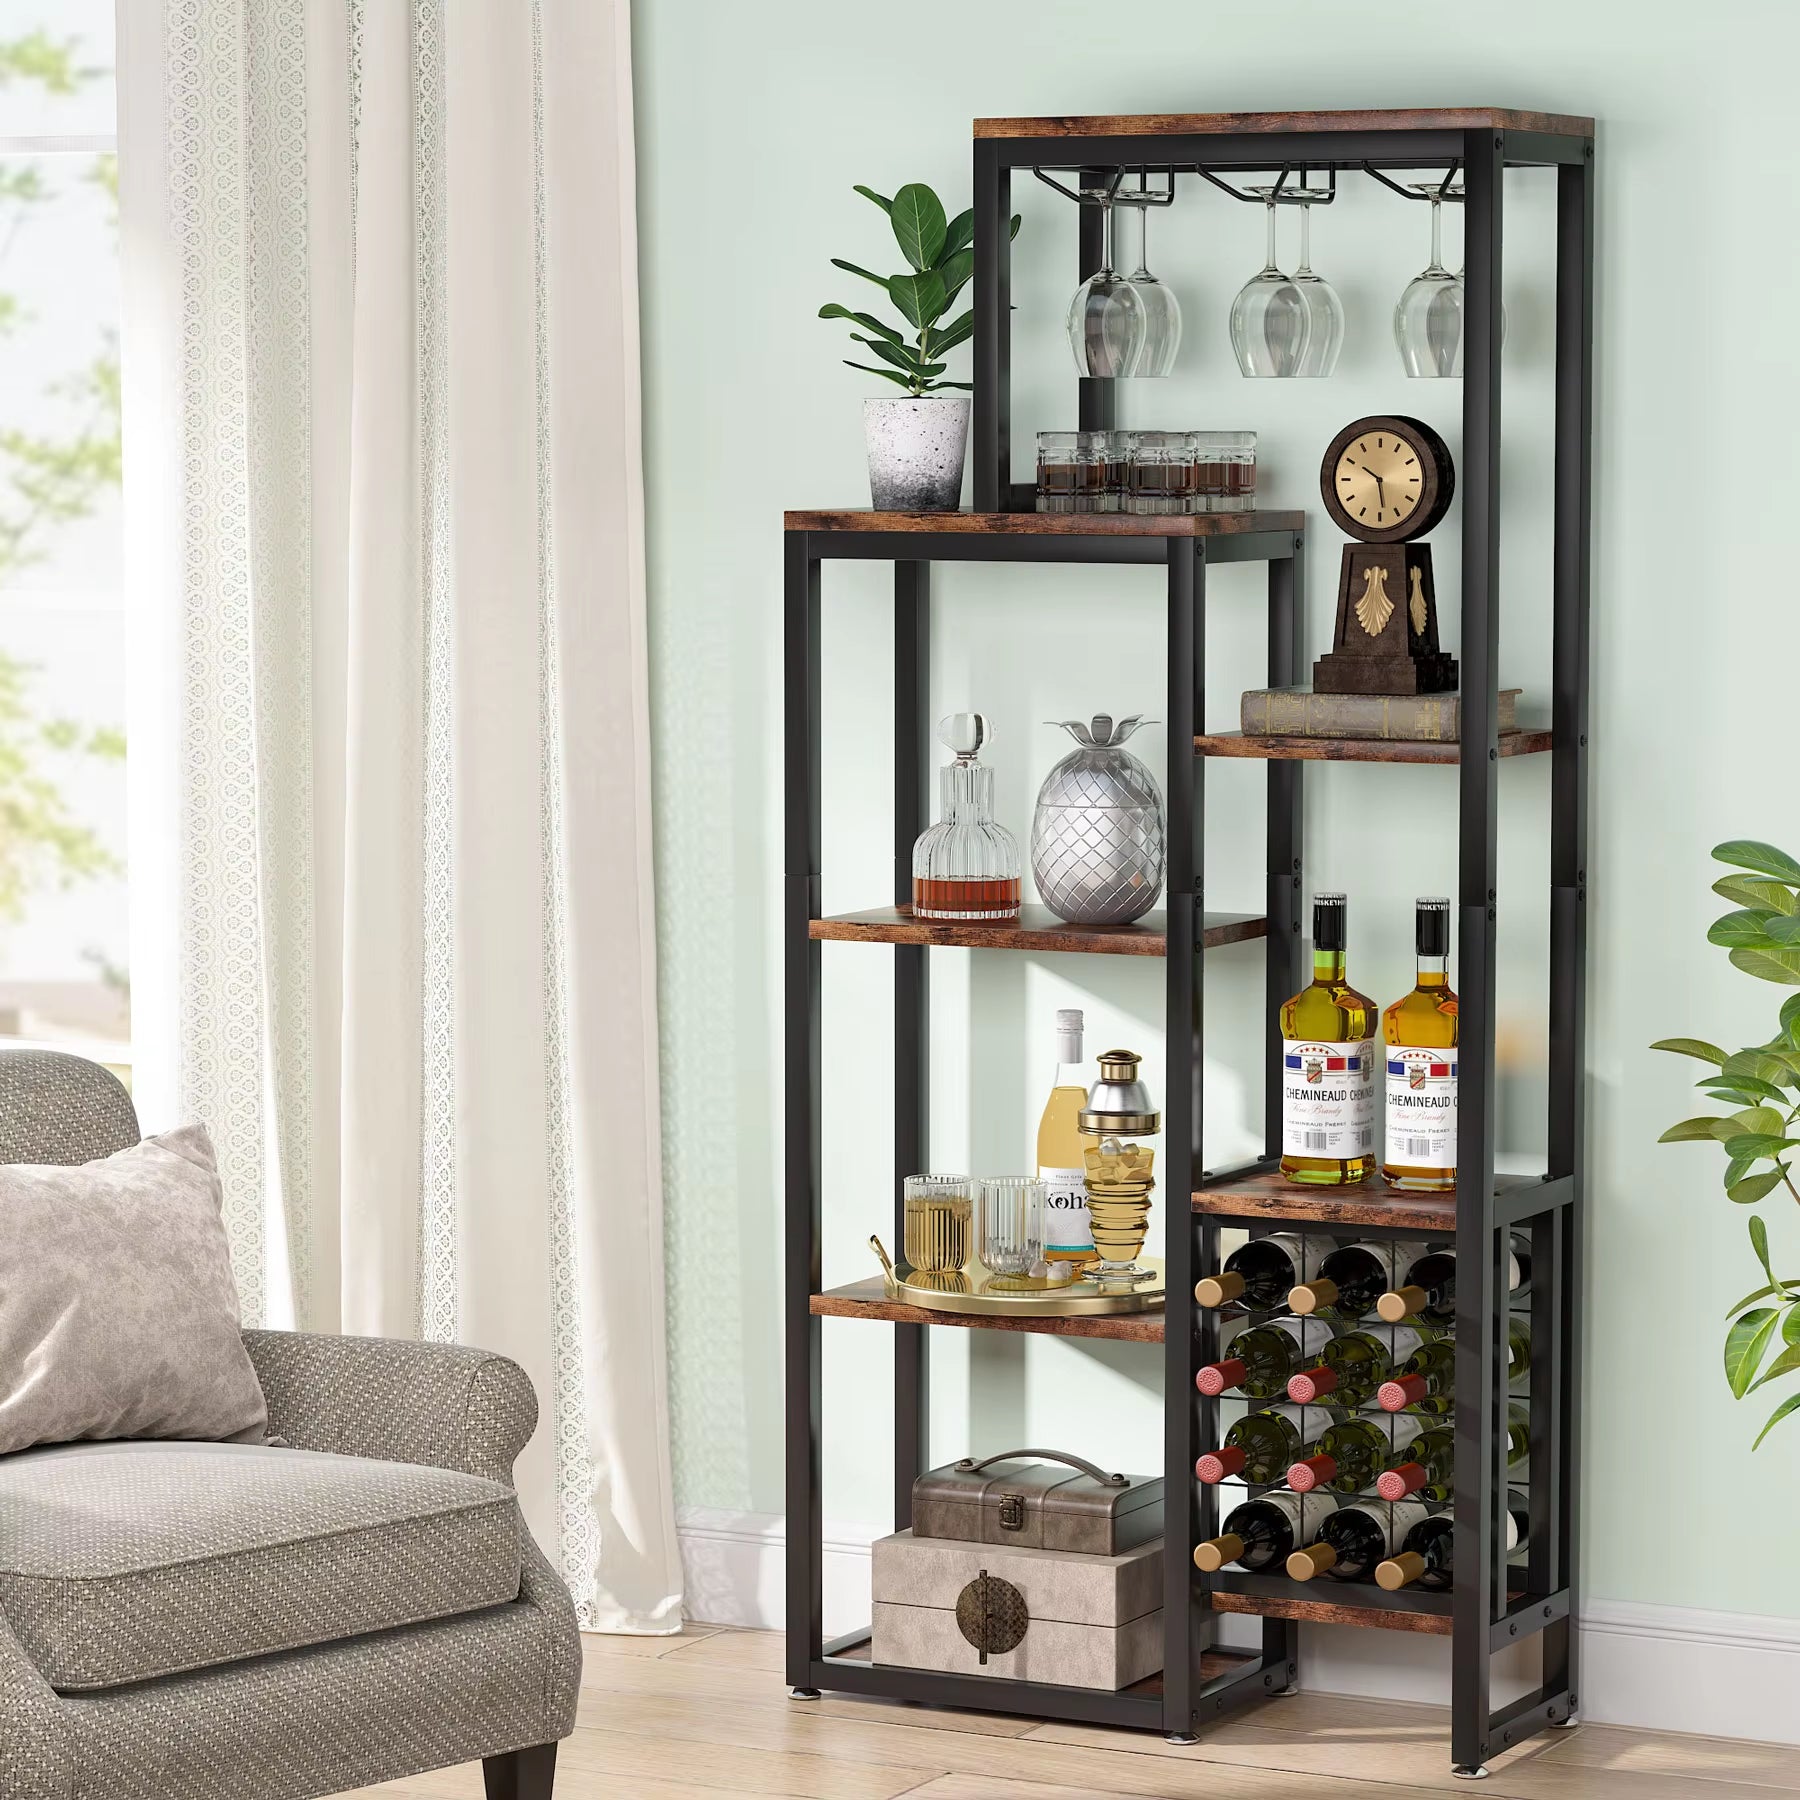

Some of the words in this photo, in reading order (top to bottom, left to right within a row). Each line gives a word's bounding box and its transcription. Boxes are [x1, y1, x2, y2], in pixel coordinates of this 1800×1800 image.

[1286, 1087, 1347, 1102] CHEMINEAUD
[1388, 1093, 1451, 1108] CHEMINEAUD
[1311, 1103, 1343, 1117] Brandy
